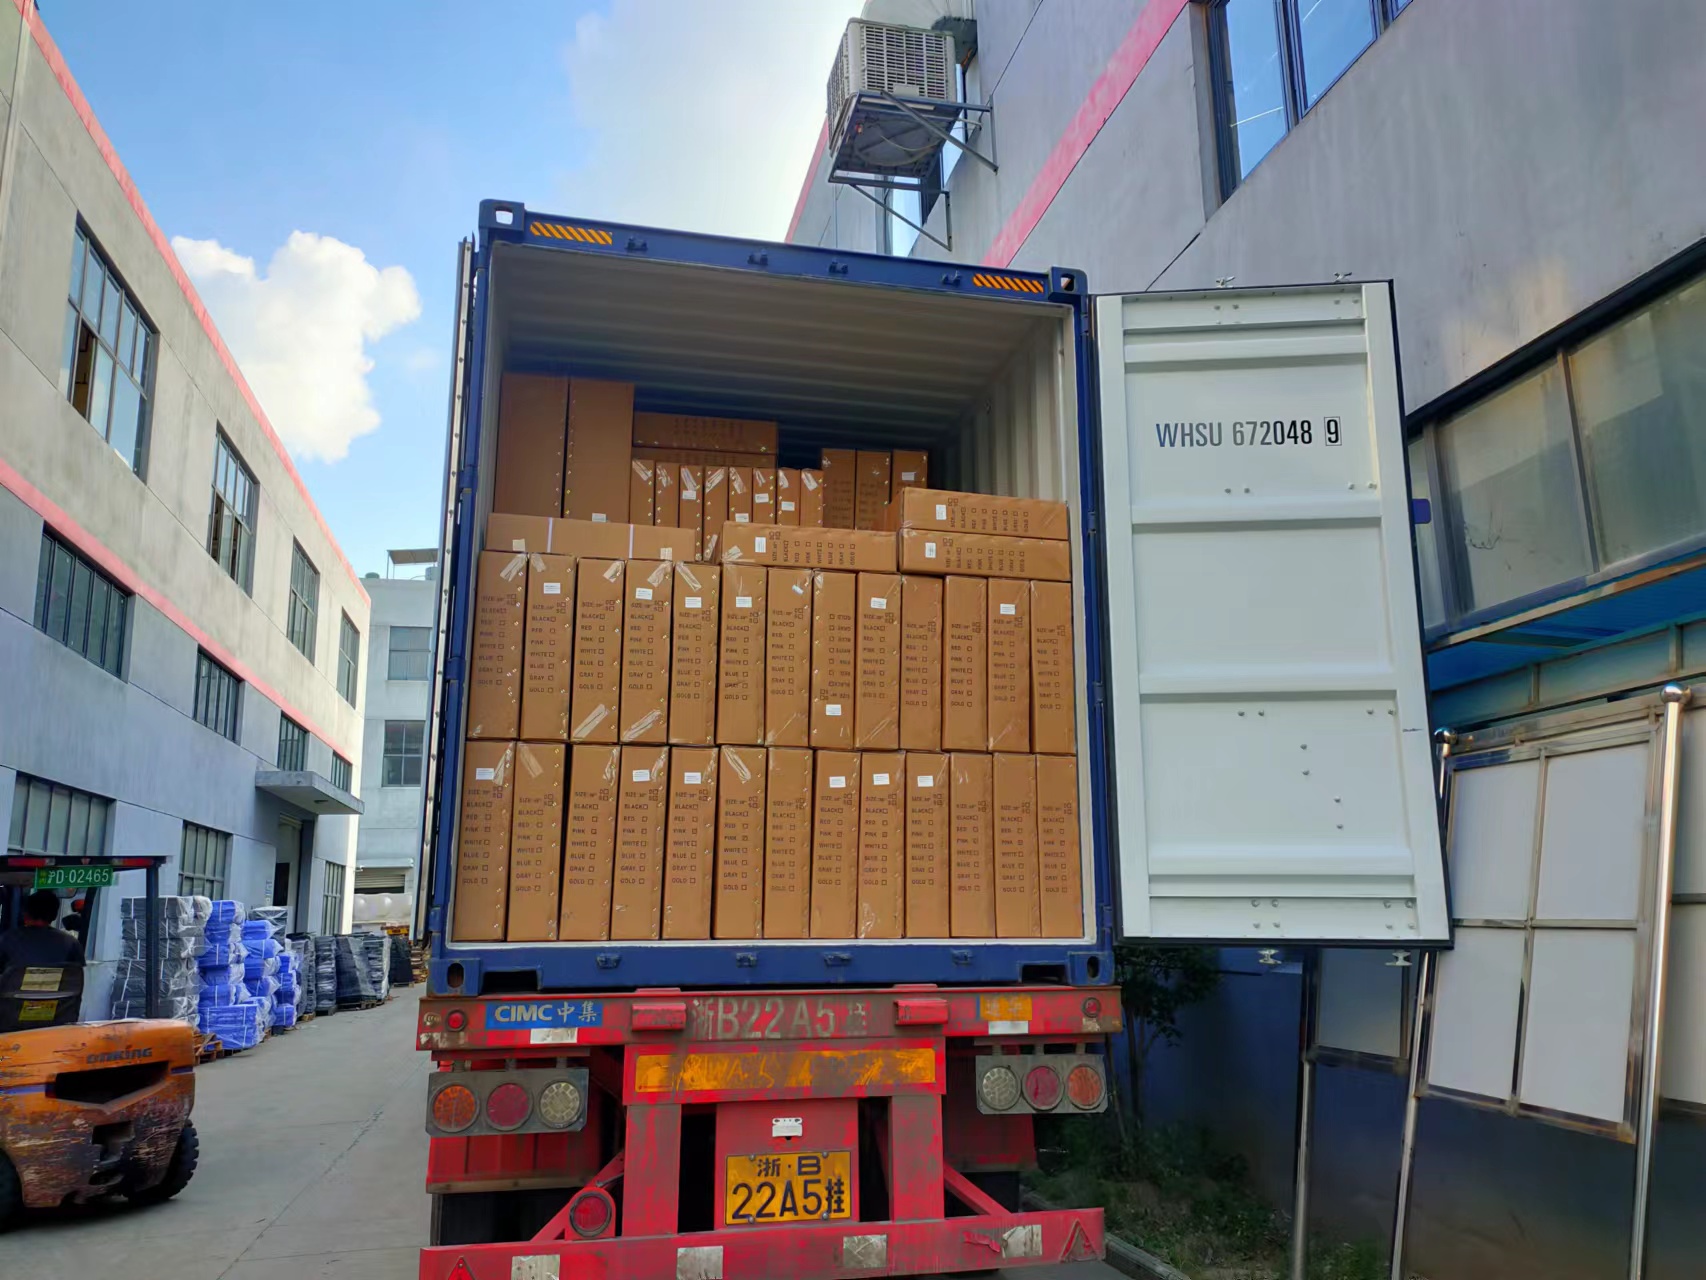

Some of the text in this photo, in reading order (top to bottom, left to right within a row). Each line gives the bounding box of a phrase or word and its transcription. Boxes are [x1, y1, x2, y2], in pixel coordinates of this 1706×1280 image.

[1156, 419, 1340, 447] WHSU 672048 9
[495, 1001, 597, 1023] CIMC 中集
[732, 1178, 845, 1219] 22A5挂
